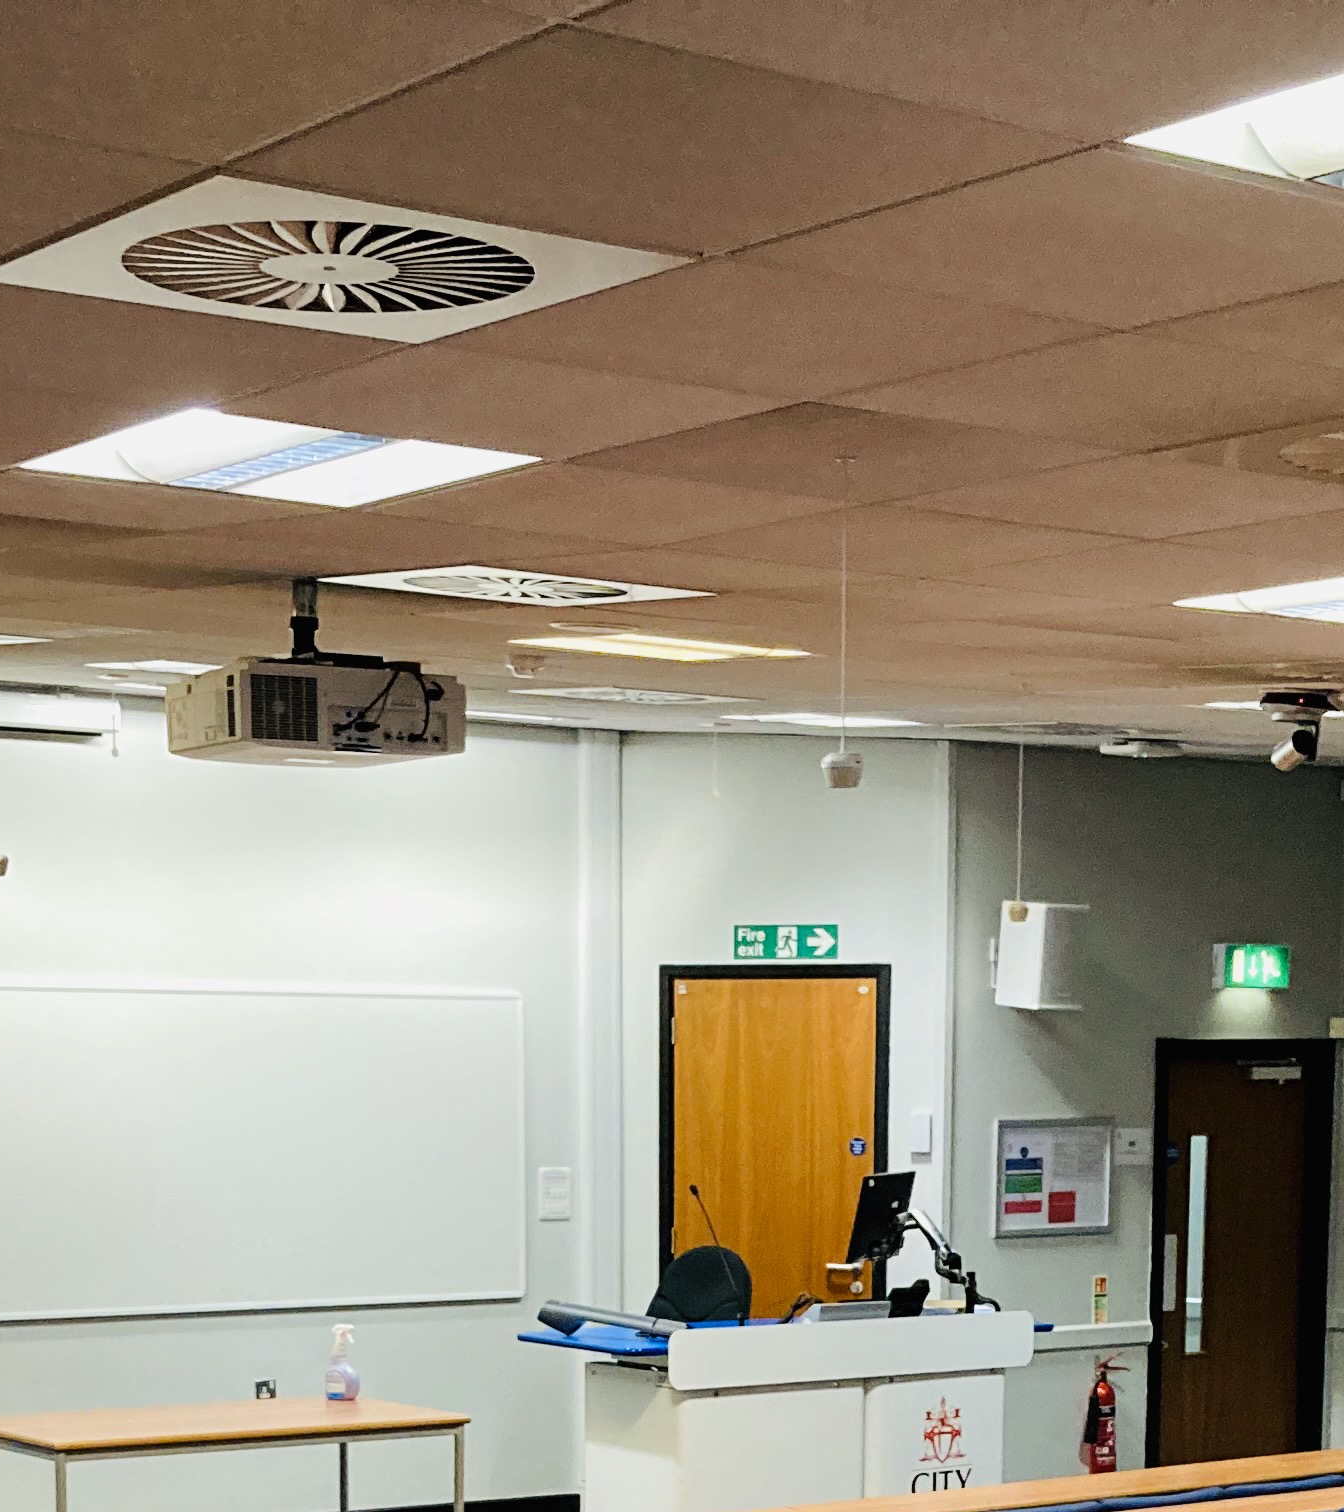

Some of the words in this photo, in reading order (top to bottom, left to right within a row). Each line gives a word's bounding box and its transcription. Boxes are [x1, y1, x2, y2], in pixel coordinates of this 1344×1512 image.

[737, 927, 766, 942] Fire
[737, 942, 764, 957] exit
[911, 1467, 972, 1494] CITY
